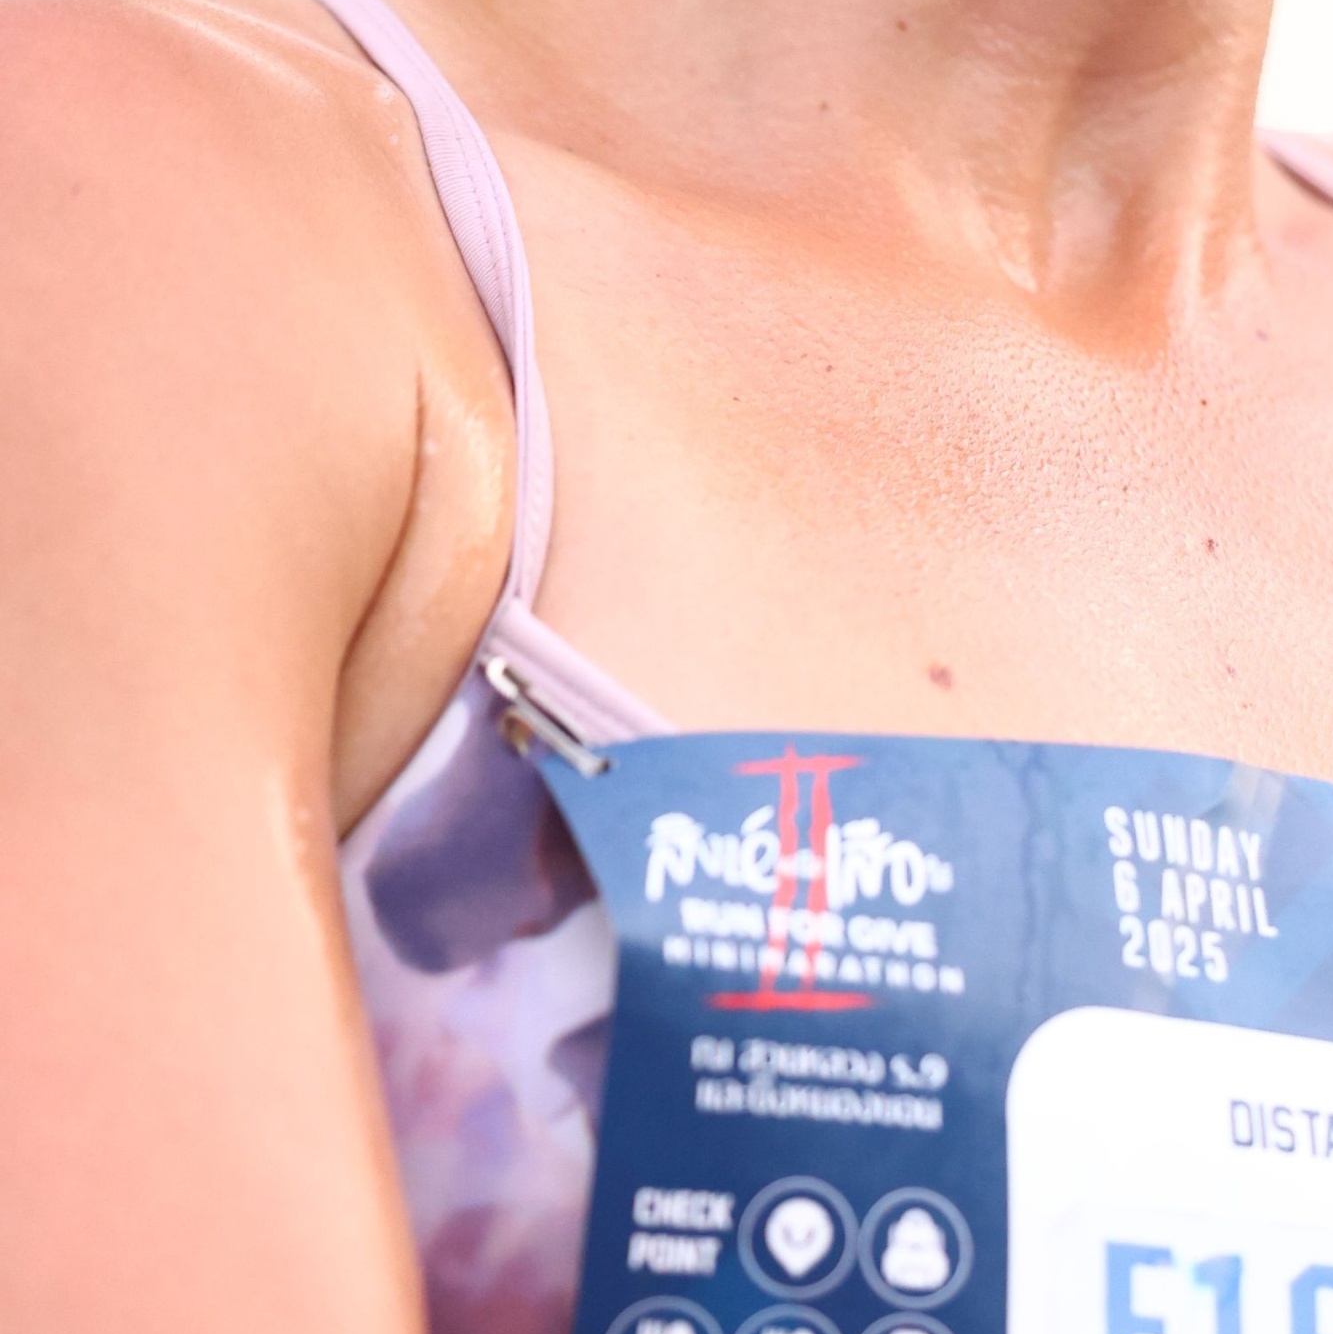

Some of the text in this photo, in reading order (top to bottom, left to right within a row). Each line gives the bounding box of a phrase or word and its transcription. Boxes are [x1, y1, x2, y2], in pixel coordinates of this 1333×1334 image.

[1104, 807, 1262, 880] SUNDAY
[1112, 861, 1279, 938] 6 APRIL
[767, 906, 846, 949] FOR
[847, 914, 938, 959] GIVE
[1119, 920, 1229, 983] 2025
[662, 935, 967, 995] MINIMARATHON
[633, 1187, 735, 1231] CHECK
[628, 1232, 721, 1276] POINT
